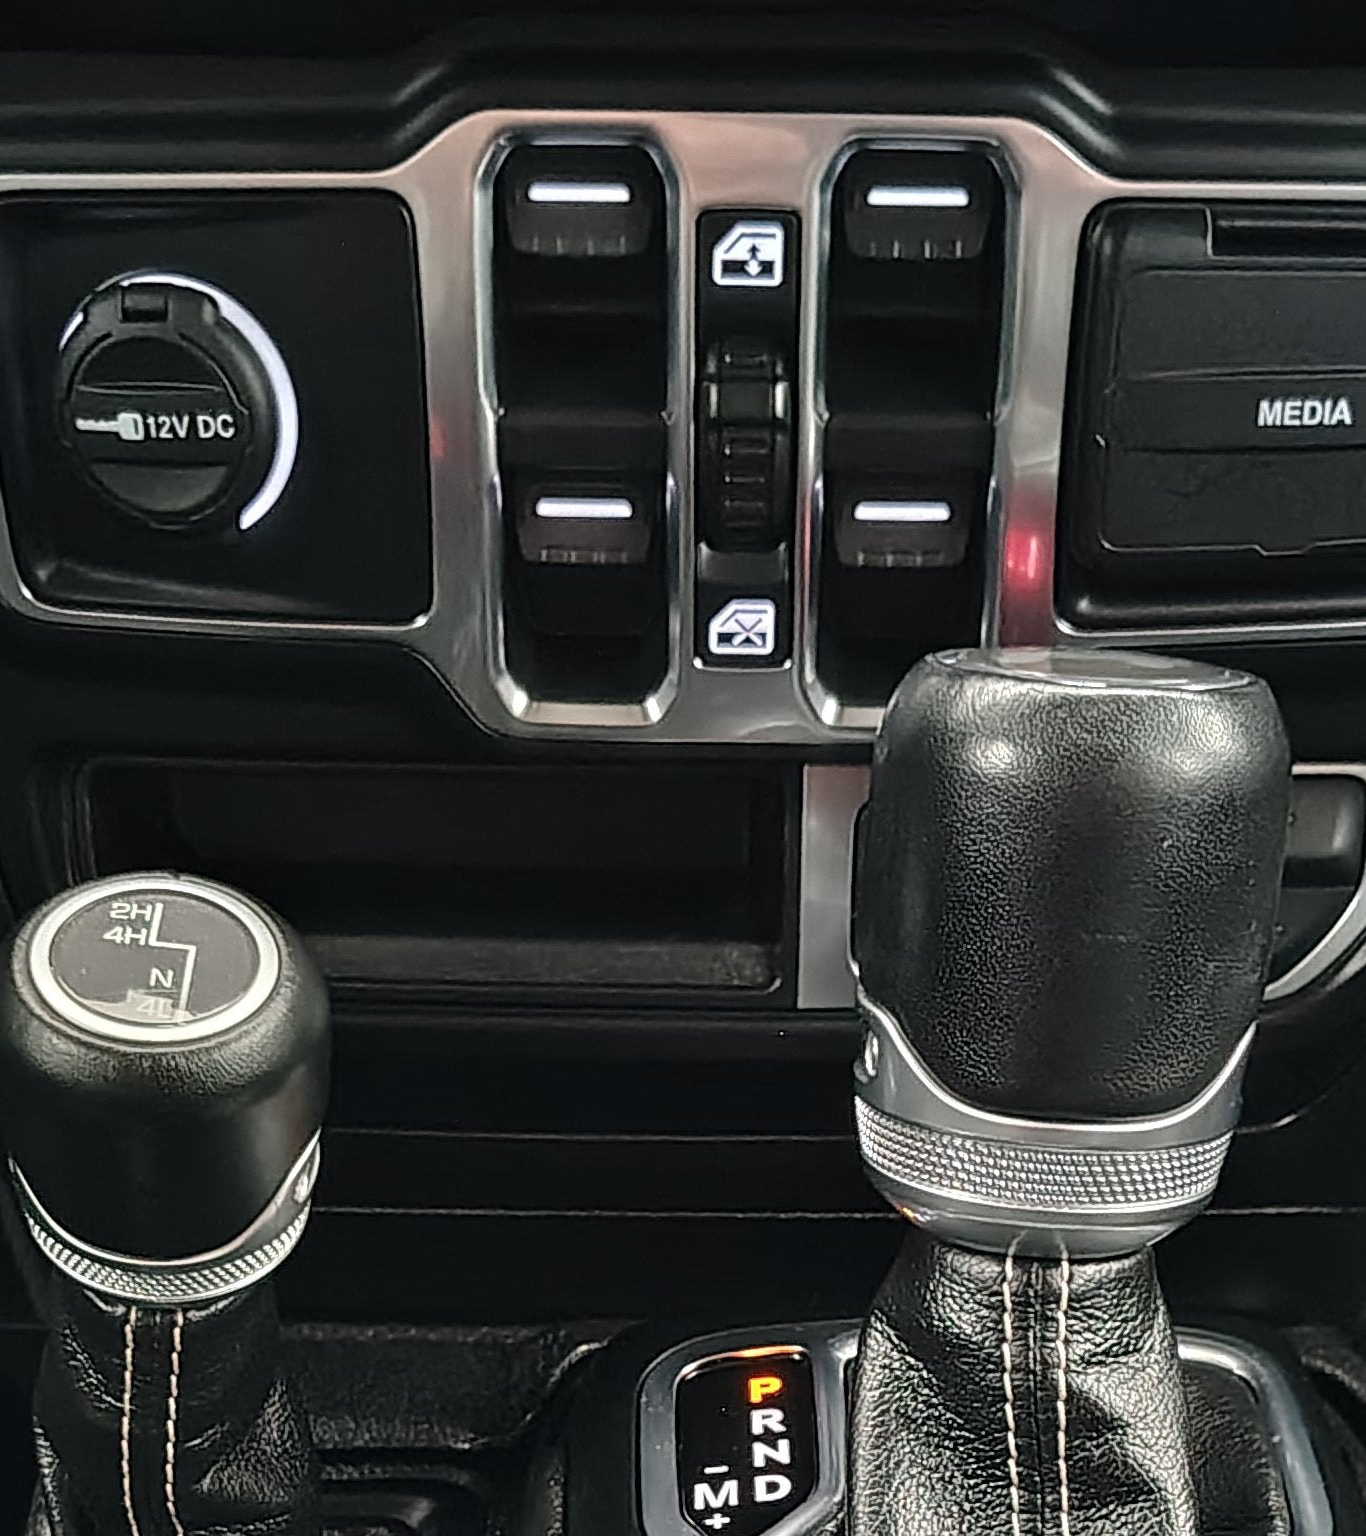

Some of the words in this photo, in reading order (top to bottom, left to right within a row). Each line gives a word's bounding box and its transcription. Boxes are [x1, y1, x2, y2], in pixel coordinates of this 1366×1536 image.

[1257, 397, 1352, 426] MEDIA
[146, 414, 189, 438] 12V
[196, 414, 235, 438] DC
[109, 902, 153, 921] 2H
[102, 925, 148, 945] 4H
[149, 967, 174, 988] N
[749, 1376, 782, 1403] P
[750, 1408, 786, 1435] R
[752, 1439, 790, 1467] N
[693, 1479, 739, 1510] M
[754, 1474, 792, 1502] D
